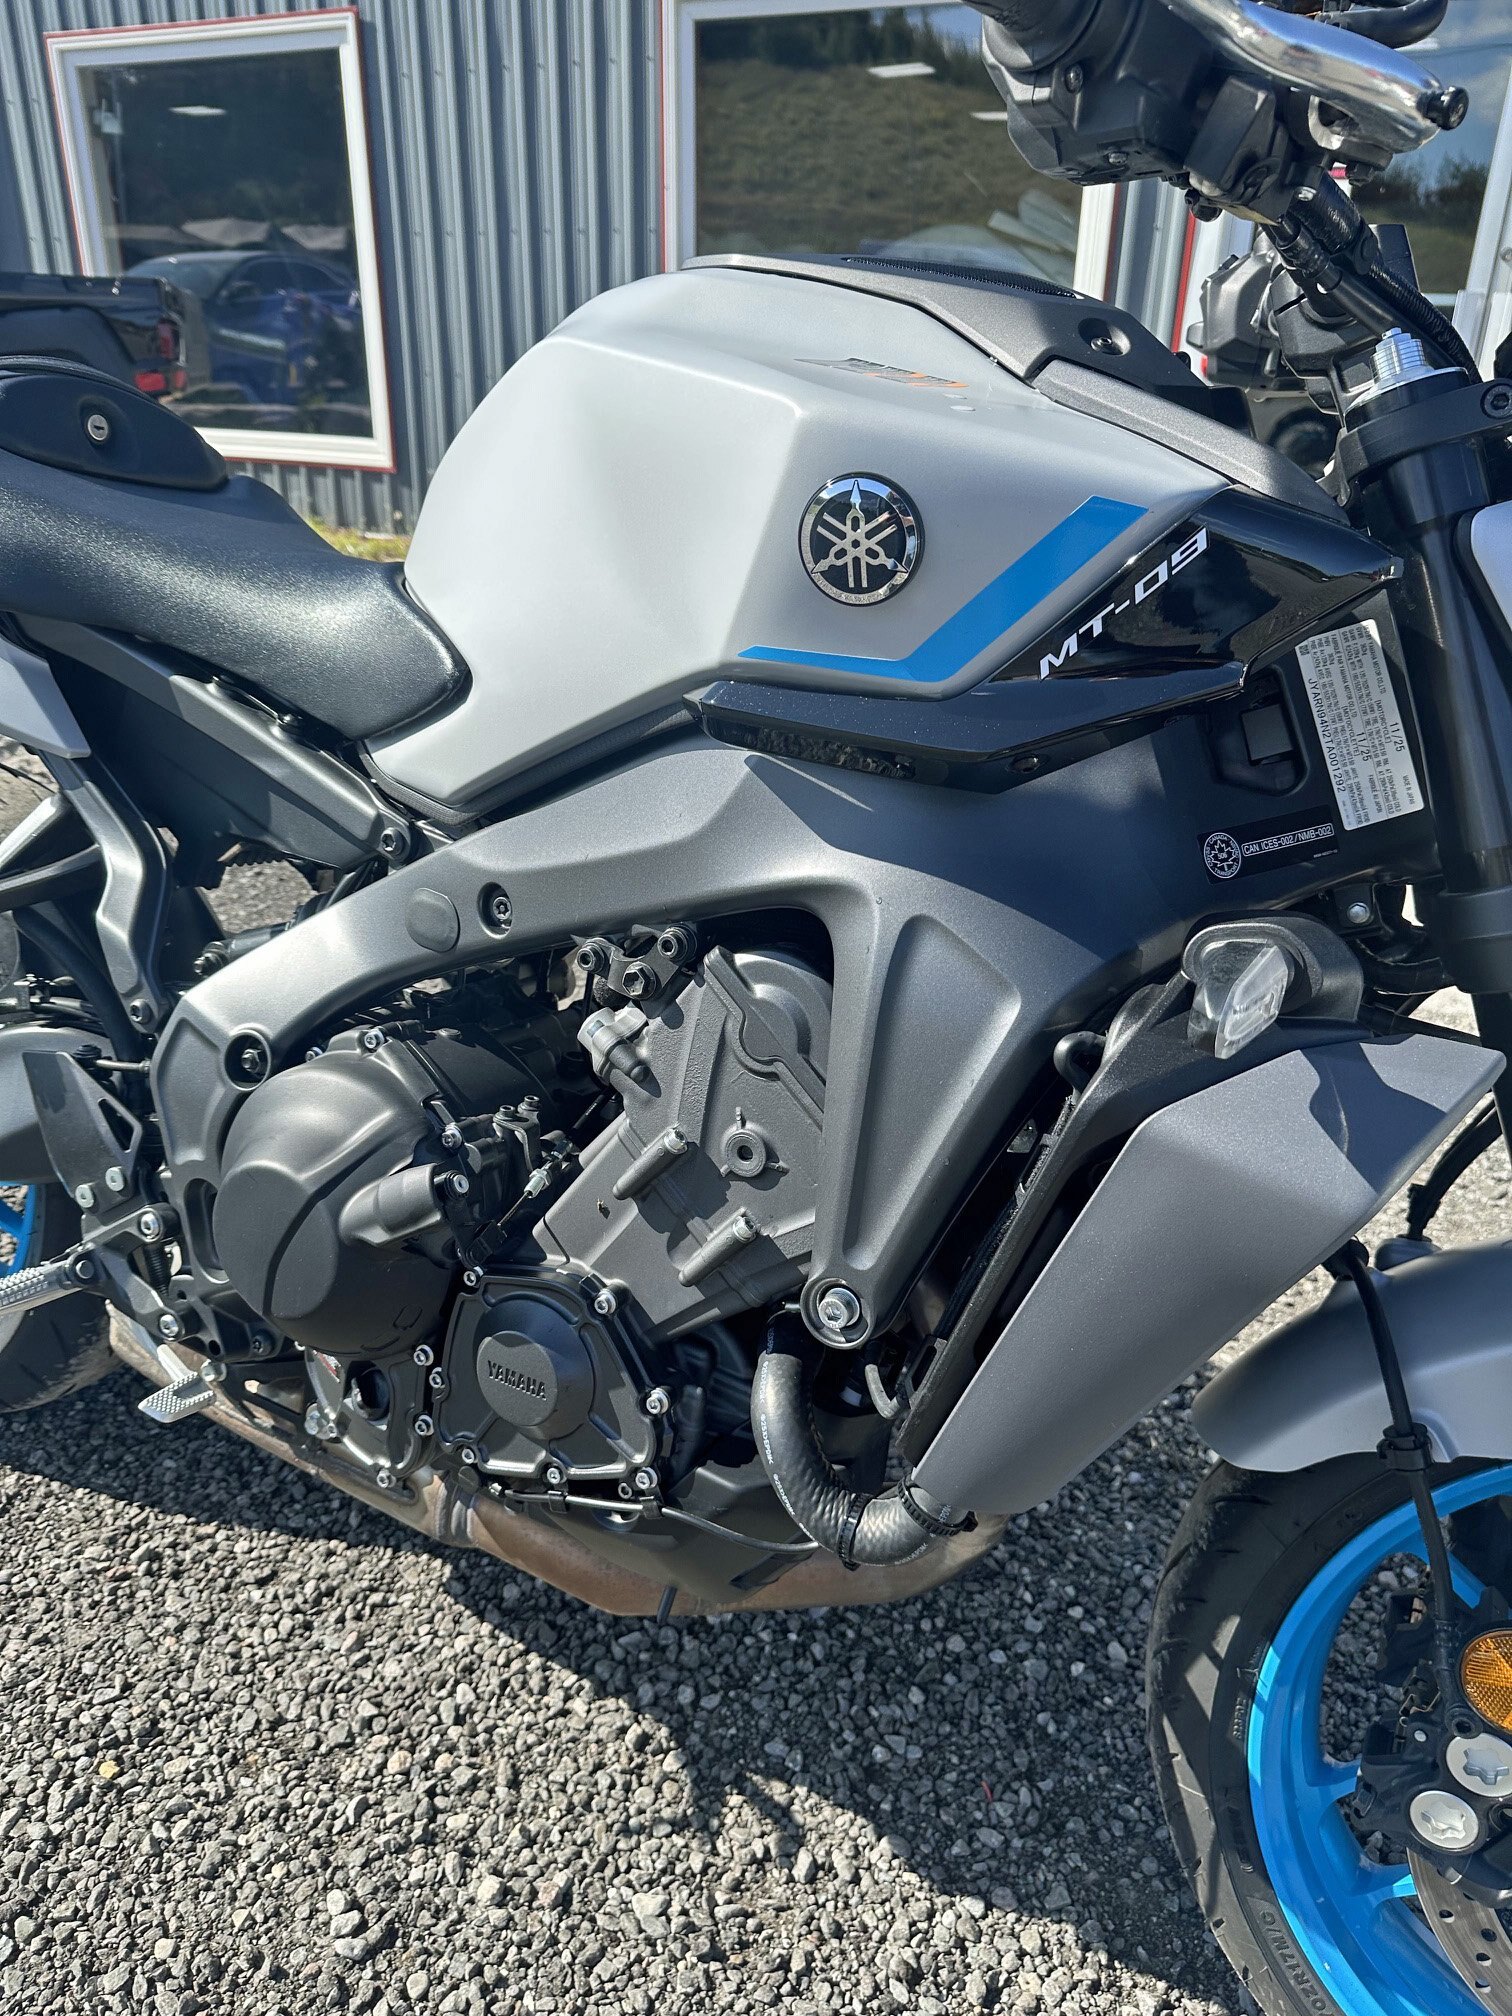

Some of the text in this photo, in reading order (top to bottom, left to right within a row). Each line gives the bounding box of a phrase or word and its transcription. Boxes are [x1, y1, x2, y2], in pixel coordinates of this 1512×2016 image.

[1039, 527, 1208, 681] MT-09
[1307, 677, 1346, 793] JYARN94N2TA001292
[1355, 731, 1373, 761] 11/25
[1388, 722, 1405, 752] 11/25
[1243, 843, 1259, 855] CAN
[487, 1360, 547, 1401] YAMAHA
